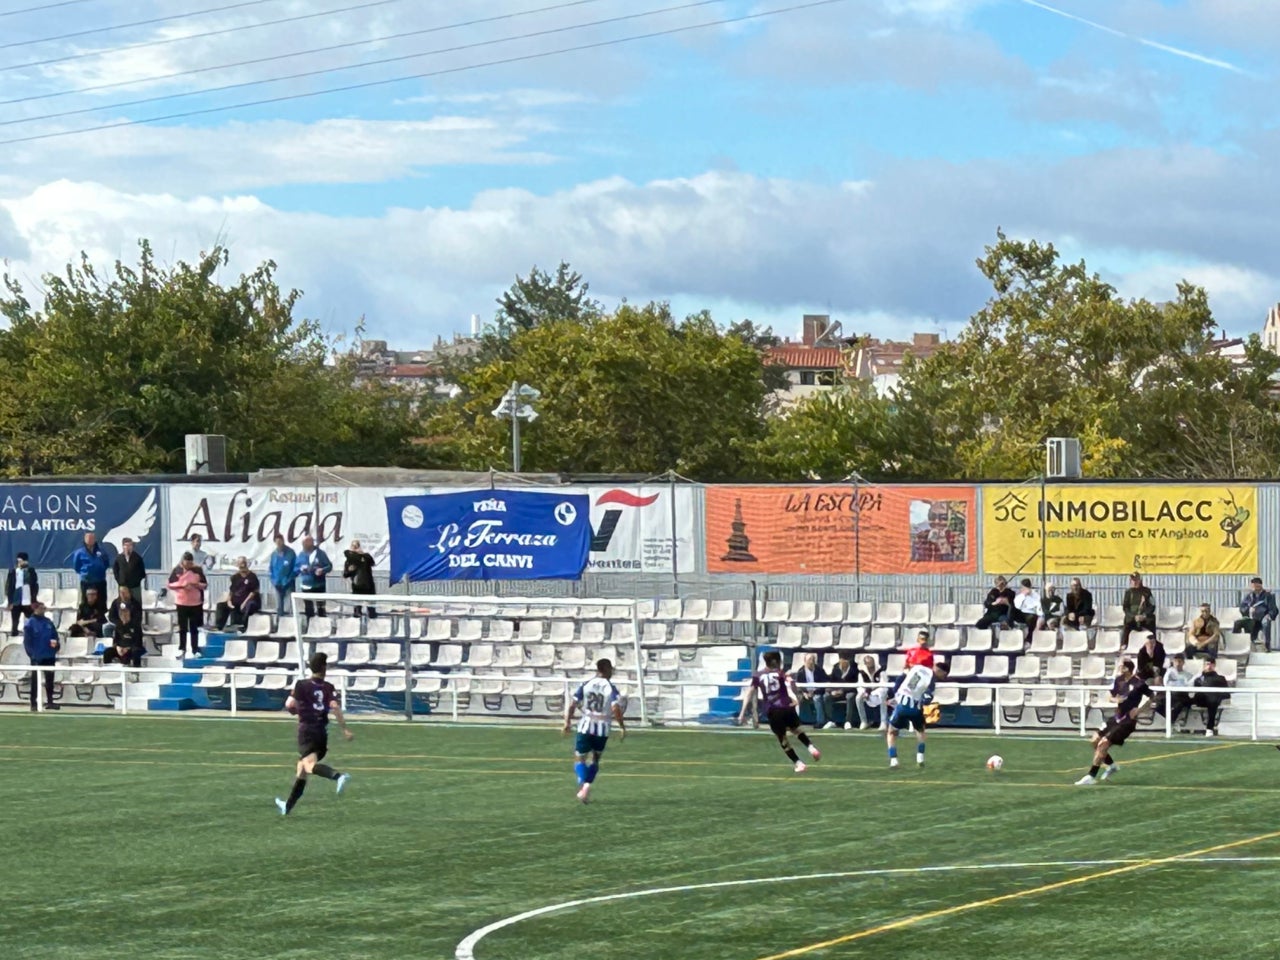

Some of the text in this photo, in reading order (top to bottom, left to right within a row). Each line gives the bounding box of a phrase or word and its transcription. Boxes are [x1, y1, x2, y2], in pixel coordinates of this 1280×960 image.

[1038, 500, 1213, 522] INMOBILACC
[31, 518, 96, 531] ARTIGAS
[464, 519, 558, 548] Terraza
[1020, 529, 1034, 539] Tu
[1111, 531, 1124, 539] en
[1128, 528, 1143, 539] Ca
[449, 553, 533, 568] DEL CANVI
[760, 673, 780, 694] 15
[313, 690, 325, 711] 3
